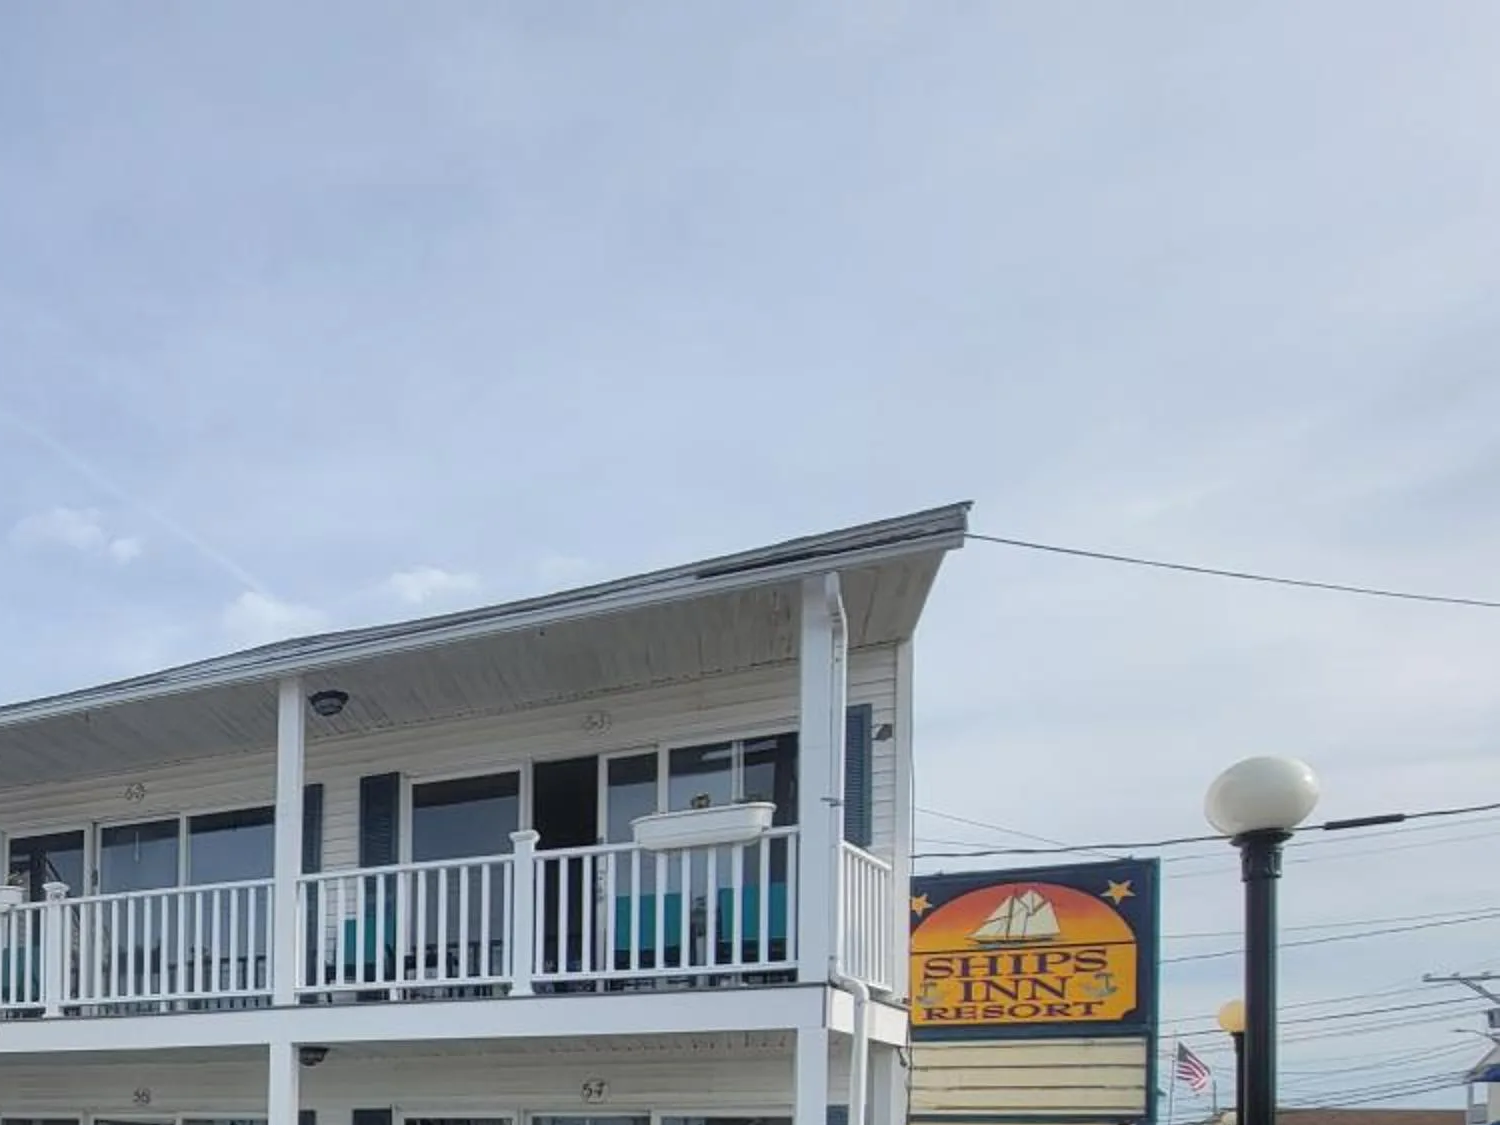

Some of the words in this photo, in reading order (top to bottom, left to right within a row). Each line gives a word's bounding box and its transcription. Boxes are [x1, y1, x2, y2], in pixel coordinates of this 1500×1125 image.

[923, 949, 1108, 980] SHIPS
[959, 975, 1074, 1003] INN
[923, 1001, 1103, 1021] RESORT
